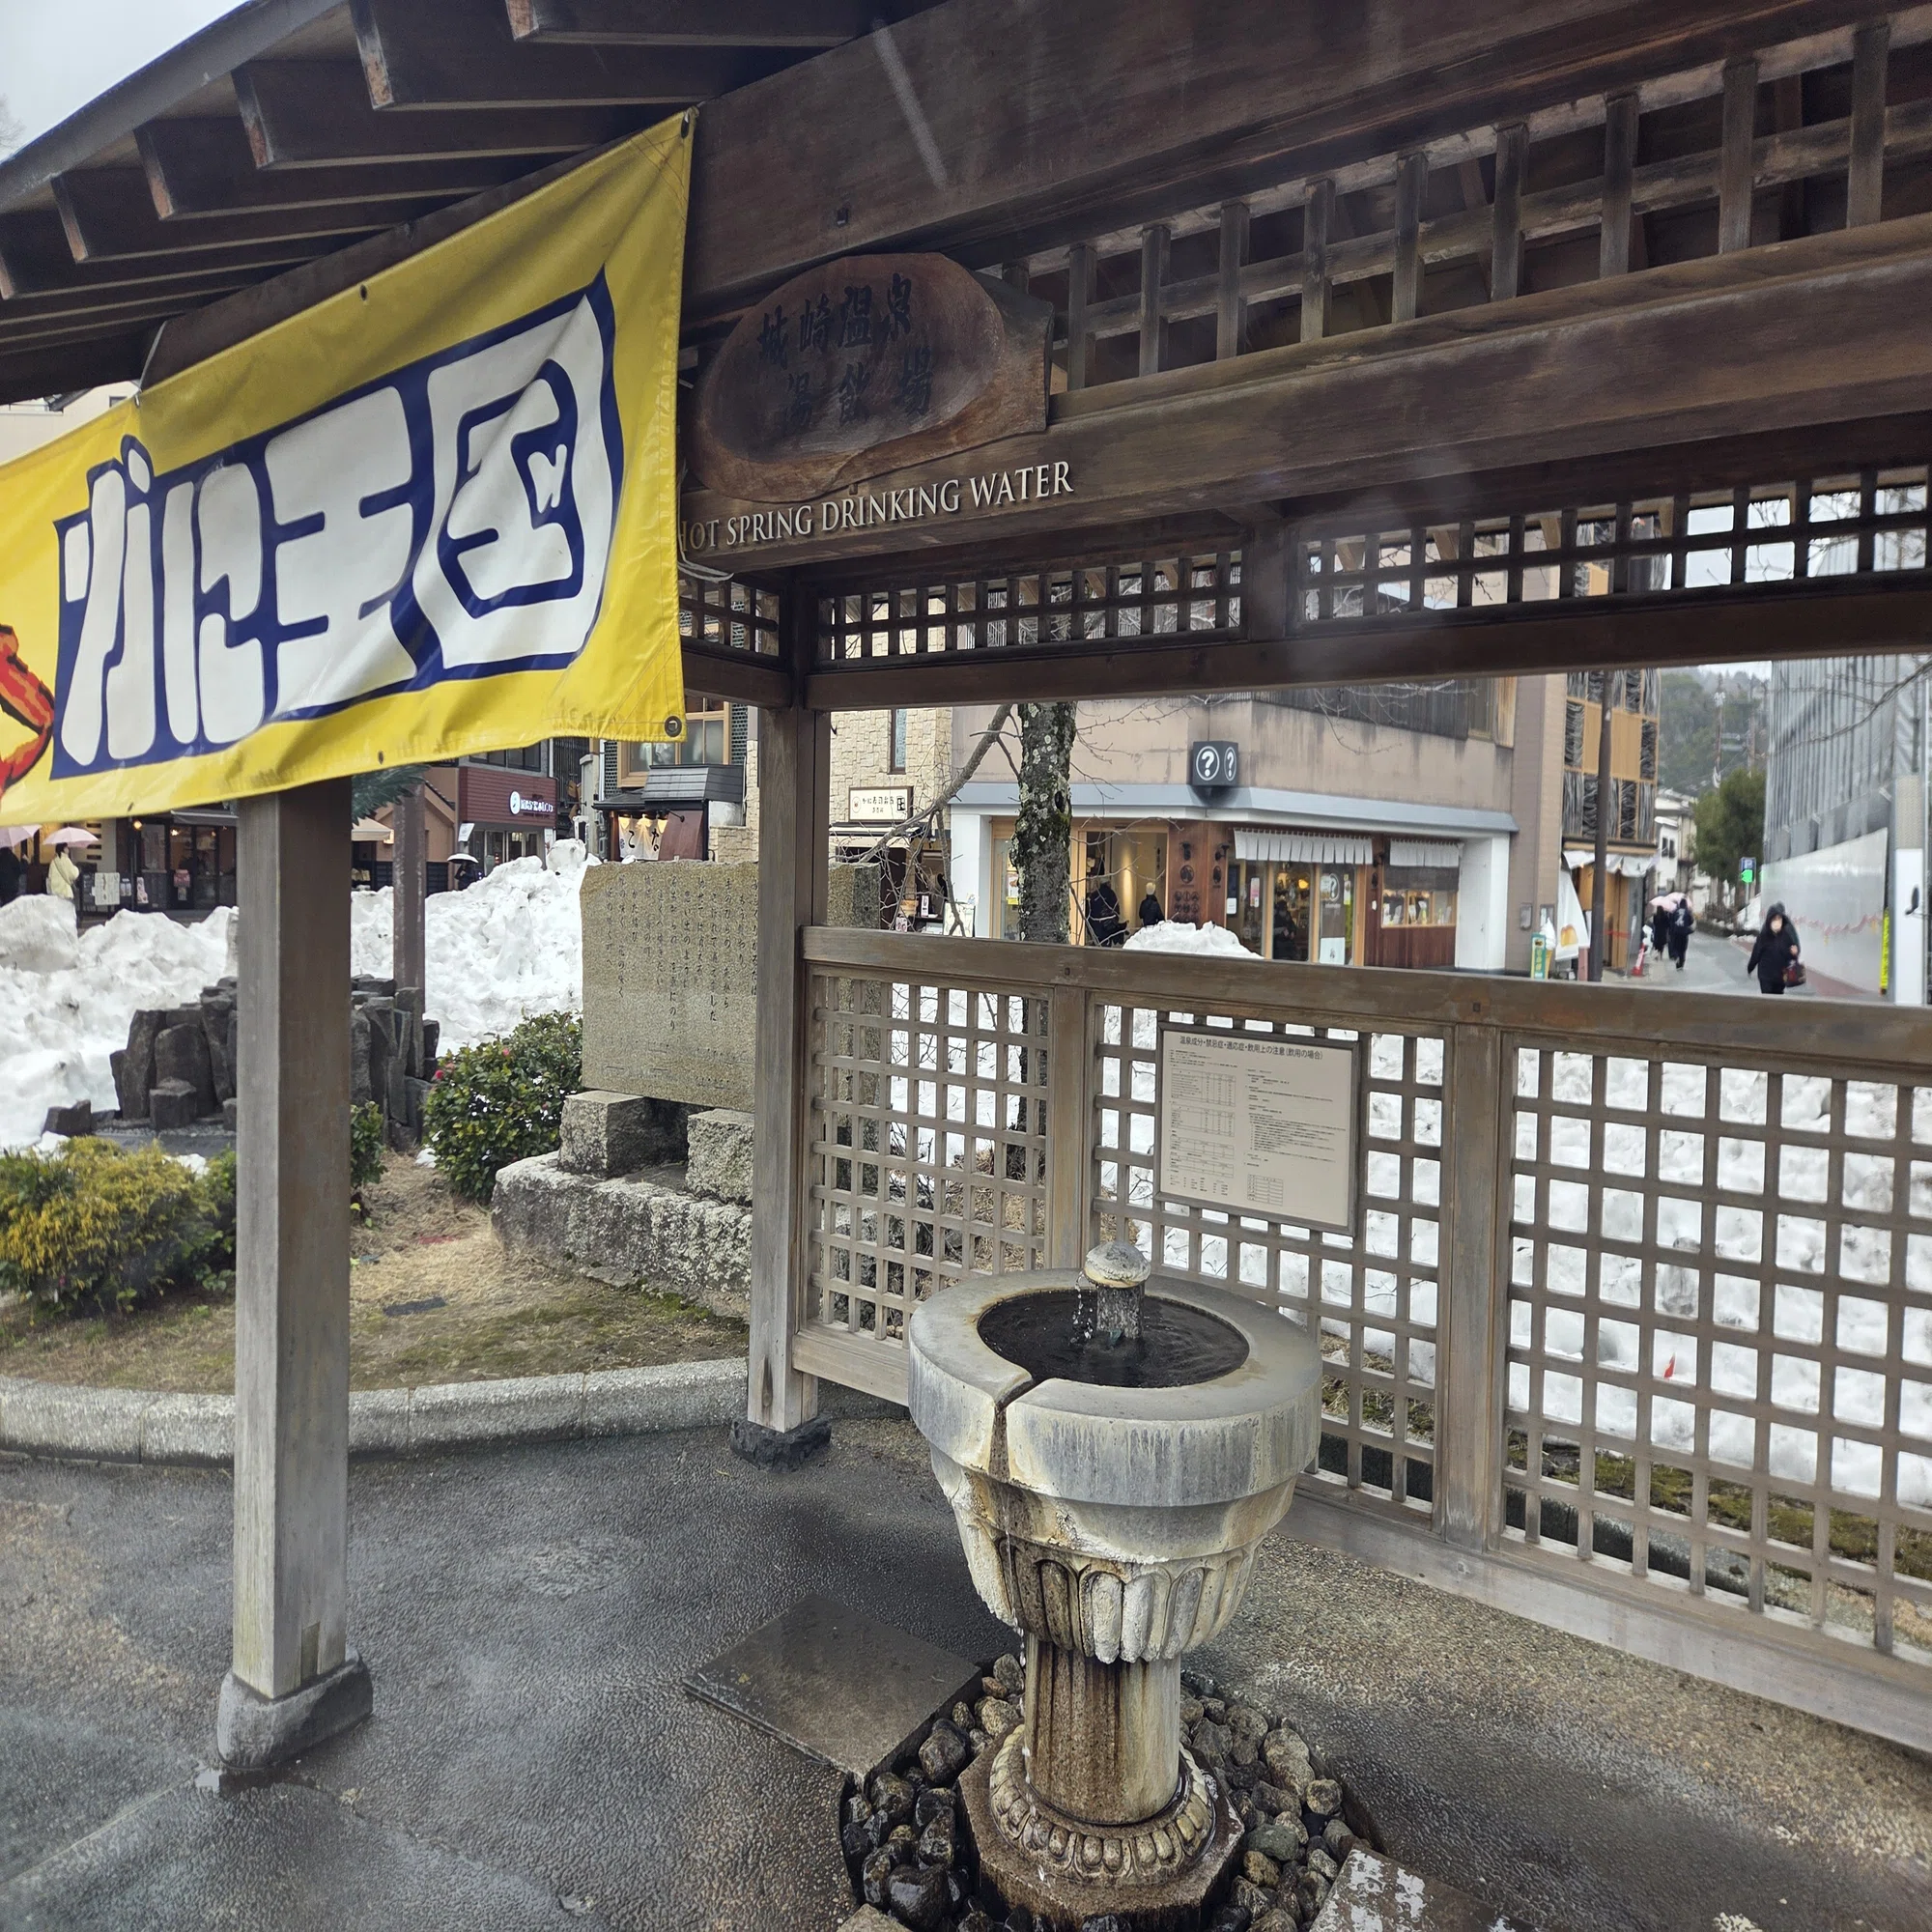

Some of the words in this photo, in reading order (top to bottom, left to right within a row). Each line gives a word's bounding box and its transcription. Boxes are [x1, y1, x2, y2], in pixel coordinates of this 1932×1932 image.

[680, 519, 720, 553] HOT
[726, 504, 813, 546] SPRING
[820, 477, 961, 533] DRINKING
[968, 459, 1074, 507] WATER
